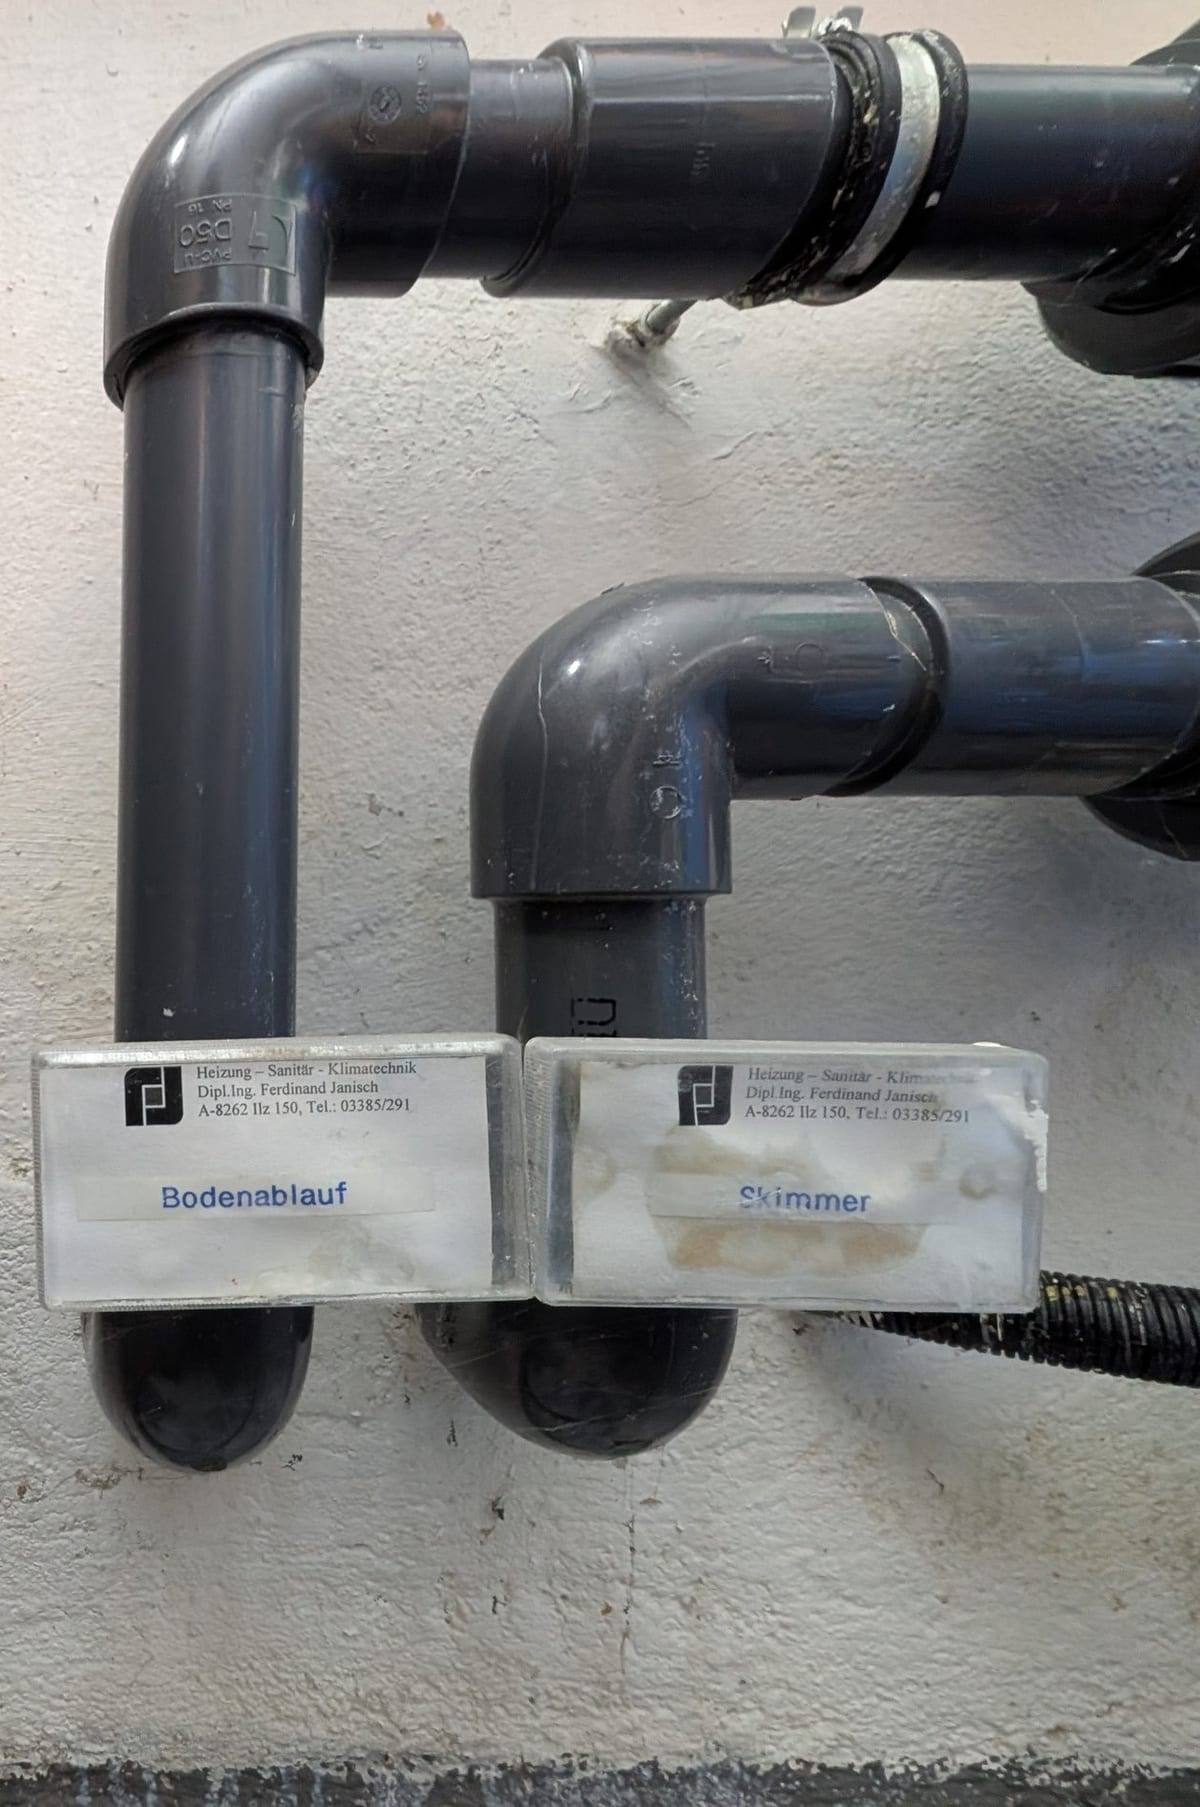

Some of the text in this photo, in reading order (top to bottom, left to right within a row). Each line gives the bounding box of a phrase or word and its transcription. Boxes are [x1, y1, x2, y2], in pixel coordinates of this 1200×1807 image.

[197, 1066, 251, 1080] Heizung
[268, 1064, 313, 1076] Sanitär
[328, 1061, 417, 1075] Klimatechnik
[748, 1068, 803, 1083] Heizung
[198, 1081, 378, 1100] Dipl.Ing. Ferdinand Janisch
[810, 1088, 880, 1101] Ferdinand
[885, 1089, 938, 1103] Janisch
[198, 1103, 248, 1117] A-8262
[253, 1103, 270, 1115] Ilz
[307, 1100, 336, 1112] Tel.:
[341, 1098, 410, 1112] 03385/291
[745, 1105, 794, 1118] A-8262
[800, 1106, 817, 1118] Ilz
[856, 1107, 887, 1120] Tel.:
[893, 1107, 969, 1122] 03385/291
[162, 1181, 347, 1209] Bodenablauf
[740, 1185, 871, 1212] Skimmer
